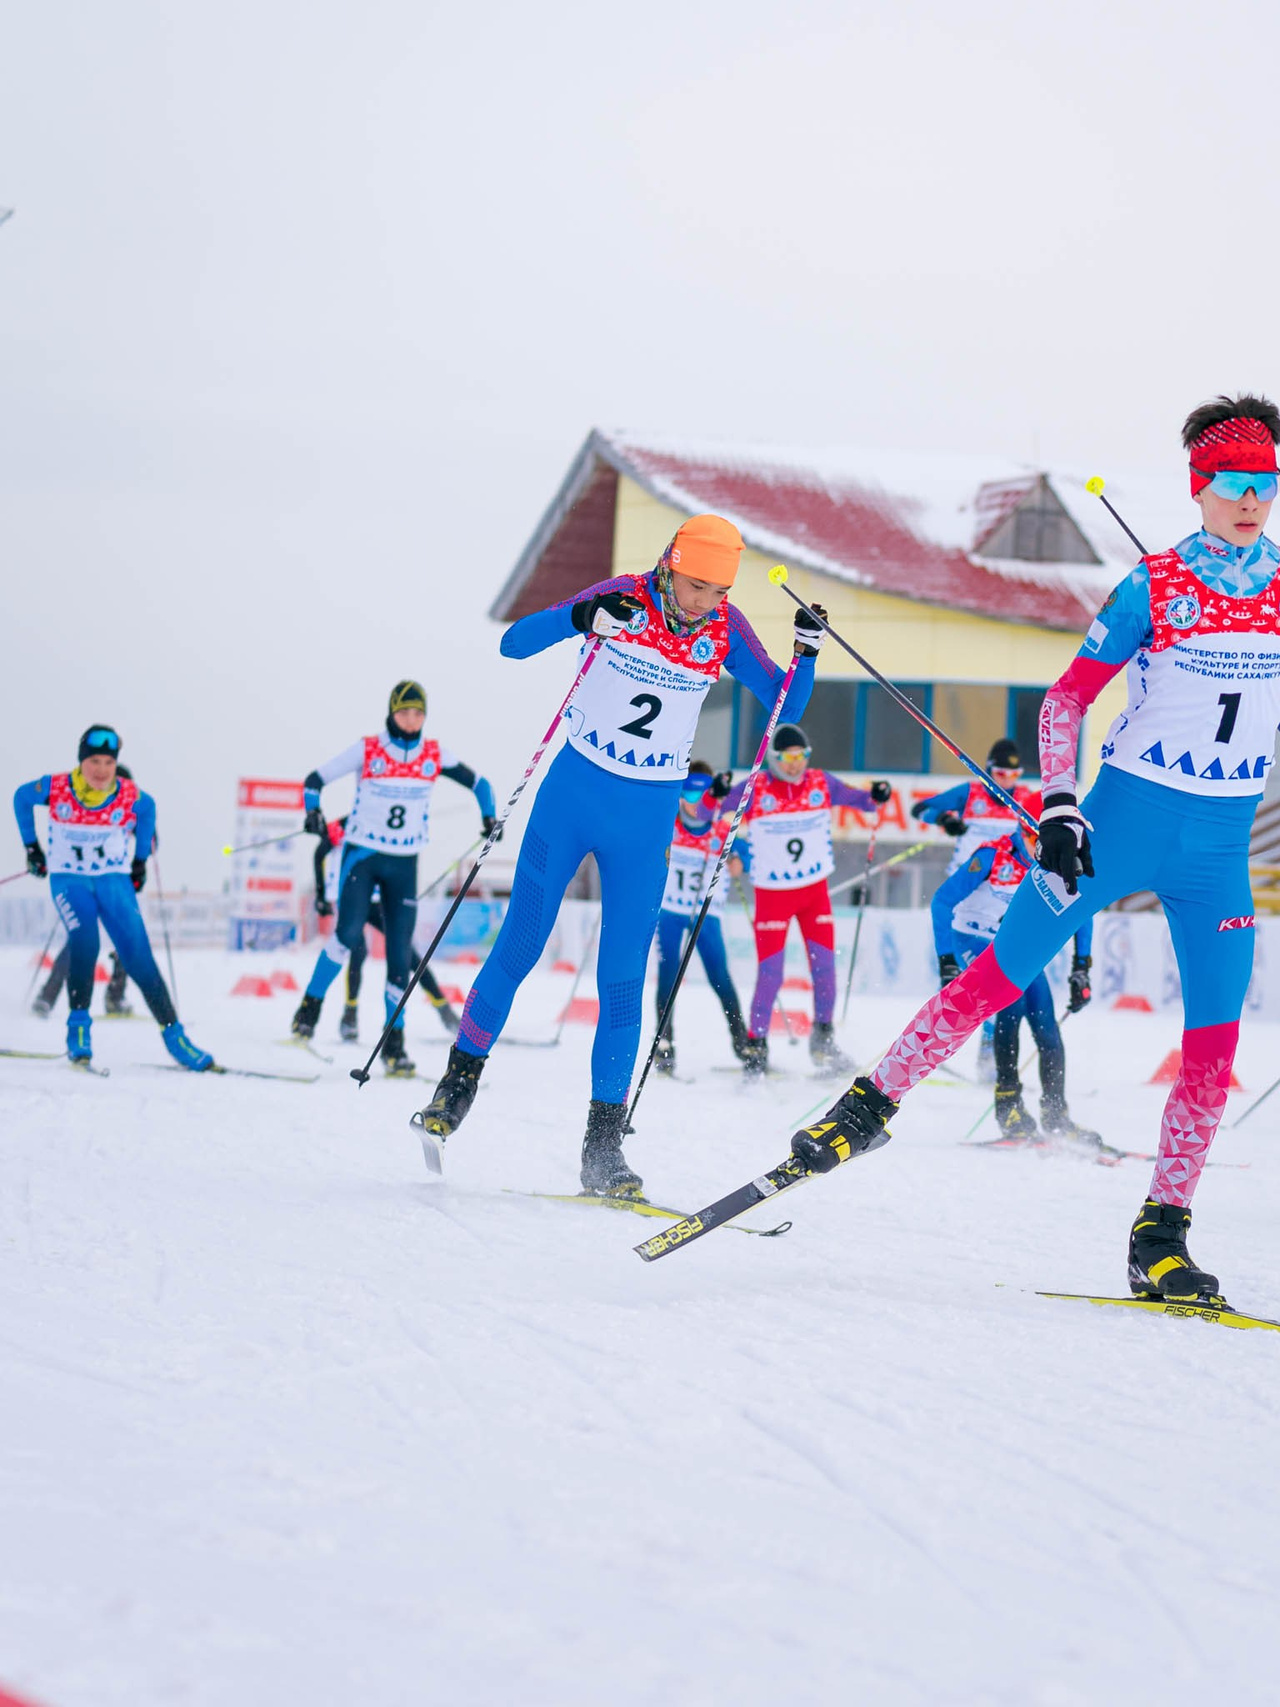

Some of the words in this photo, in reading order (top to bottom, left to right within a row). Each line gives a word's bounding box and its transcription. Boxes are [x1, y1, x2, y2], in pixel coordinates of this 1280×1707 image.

[1241, 652, 1254, 660] ПО
[624, 662, 659, 680] КУЛЬТУРЕ
[661, 667, 673, 676] ПО
[1174, 660, 1235, 680] РЕСПУБЛИКИ
[617, 693, 663, 740] 2
[1214, 692, 1242, 744] 1
[386, 804, 407, 830] 8
[71, 845, 105, 861] 11
[786, 837, 804, 863] 9
[675, 869, 704, 892] 13
[1037, 877, 1065, 913] GAZPROM
[641, 1215, 704, 1258] FISCHER
[1164, 1304, 1221, 1323] FISCHER
